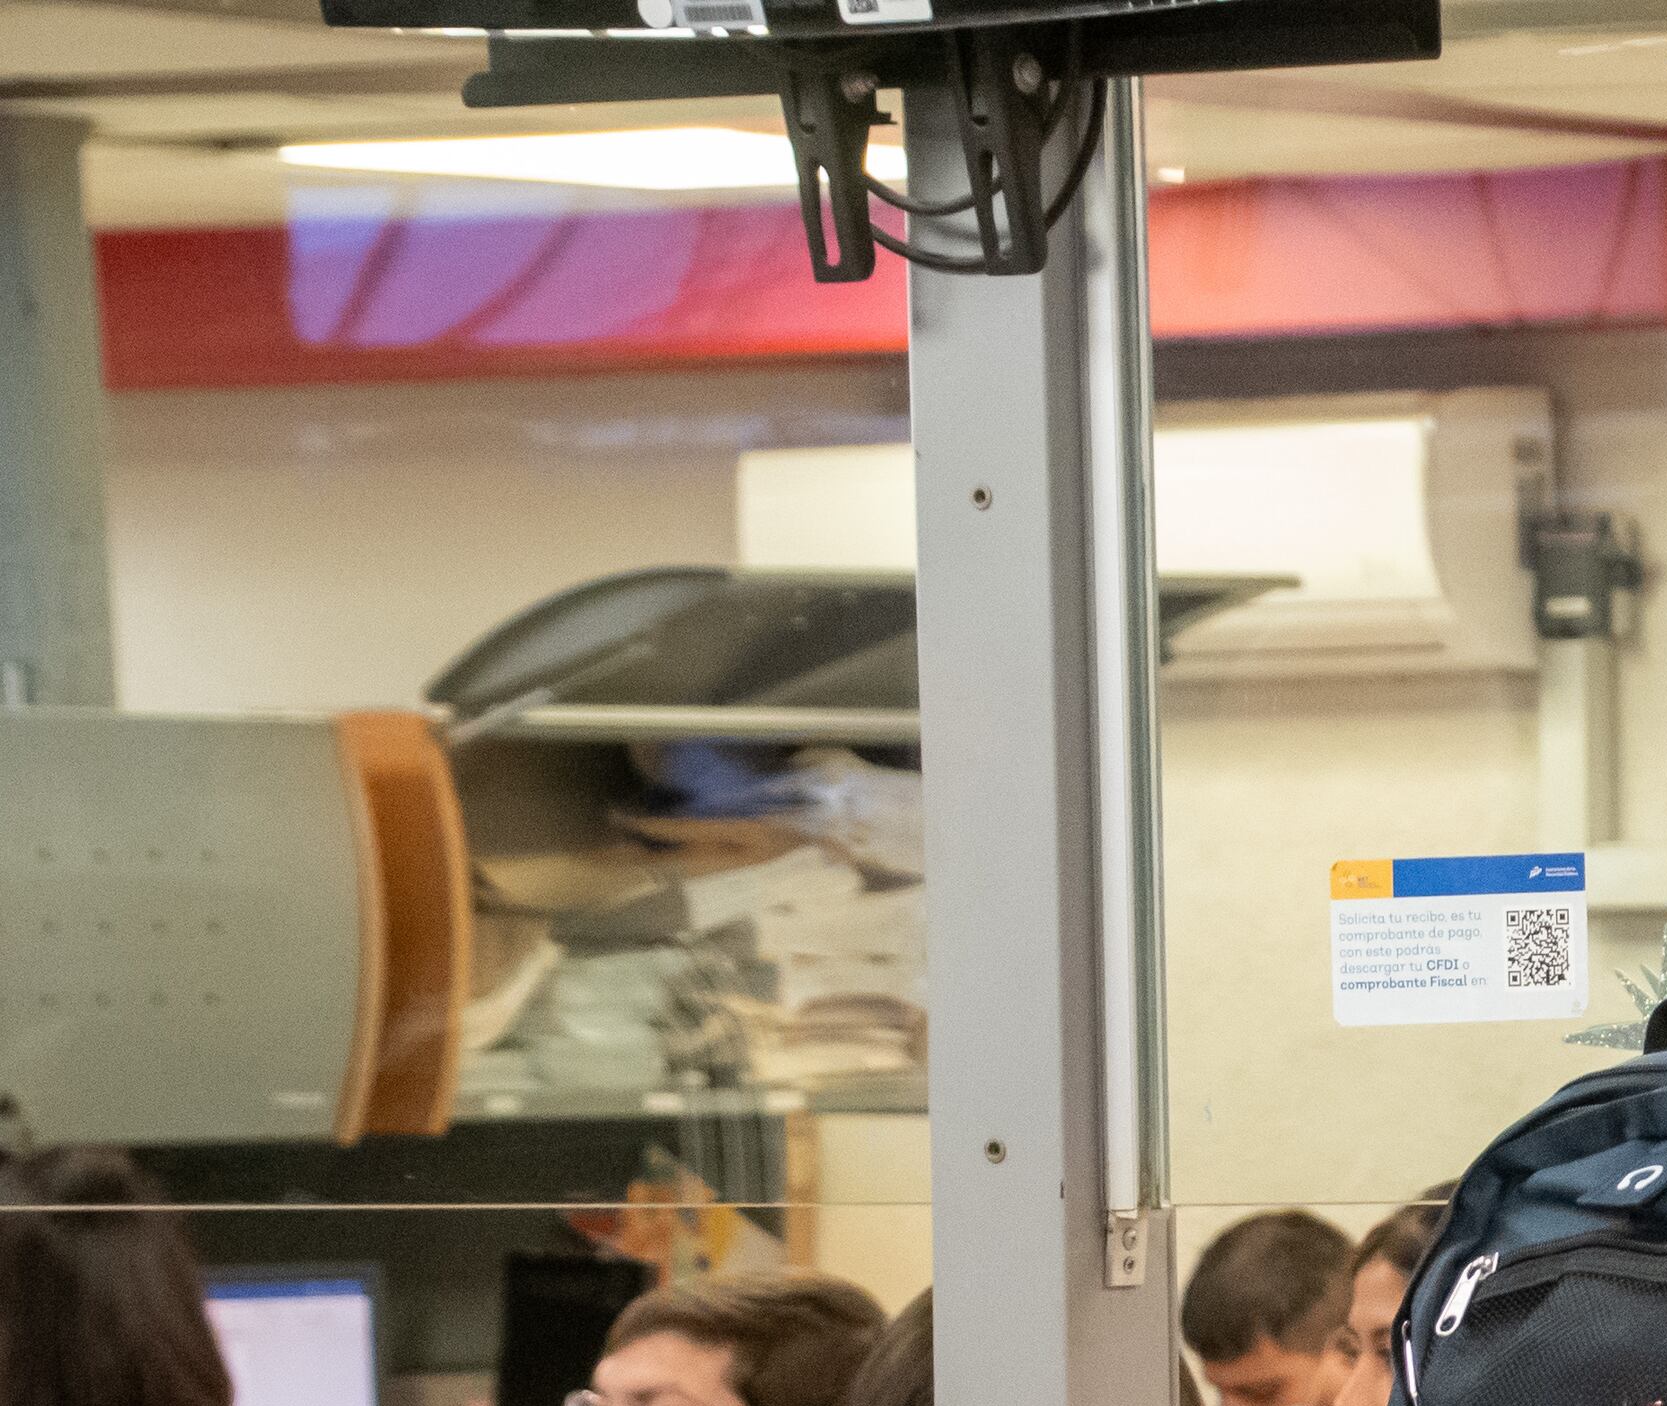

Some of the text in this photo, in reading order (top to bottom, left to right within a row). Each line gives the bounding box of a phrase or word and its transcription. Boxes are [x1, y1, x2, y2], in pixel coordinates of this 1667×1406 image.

[1338, 913, 1385, 925] Solicita
[1388, 914, 1402, 924] tu
[1450, 912, 1465, 922] es
[1468, 909, 1481, 921] tu
[1339, 929, 1425, 943] comprobante
[1428, 927, 1444, 938] de
[1339, 948, 1362, 958] con
[1365, 947, 1392, 957] este
[1340, 959, 1470, 976] descargar tu CFDI o
[1340, 976, 1427, 992] comprobante
[1430, 974, 1467, 988] Fiscal
